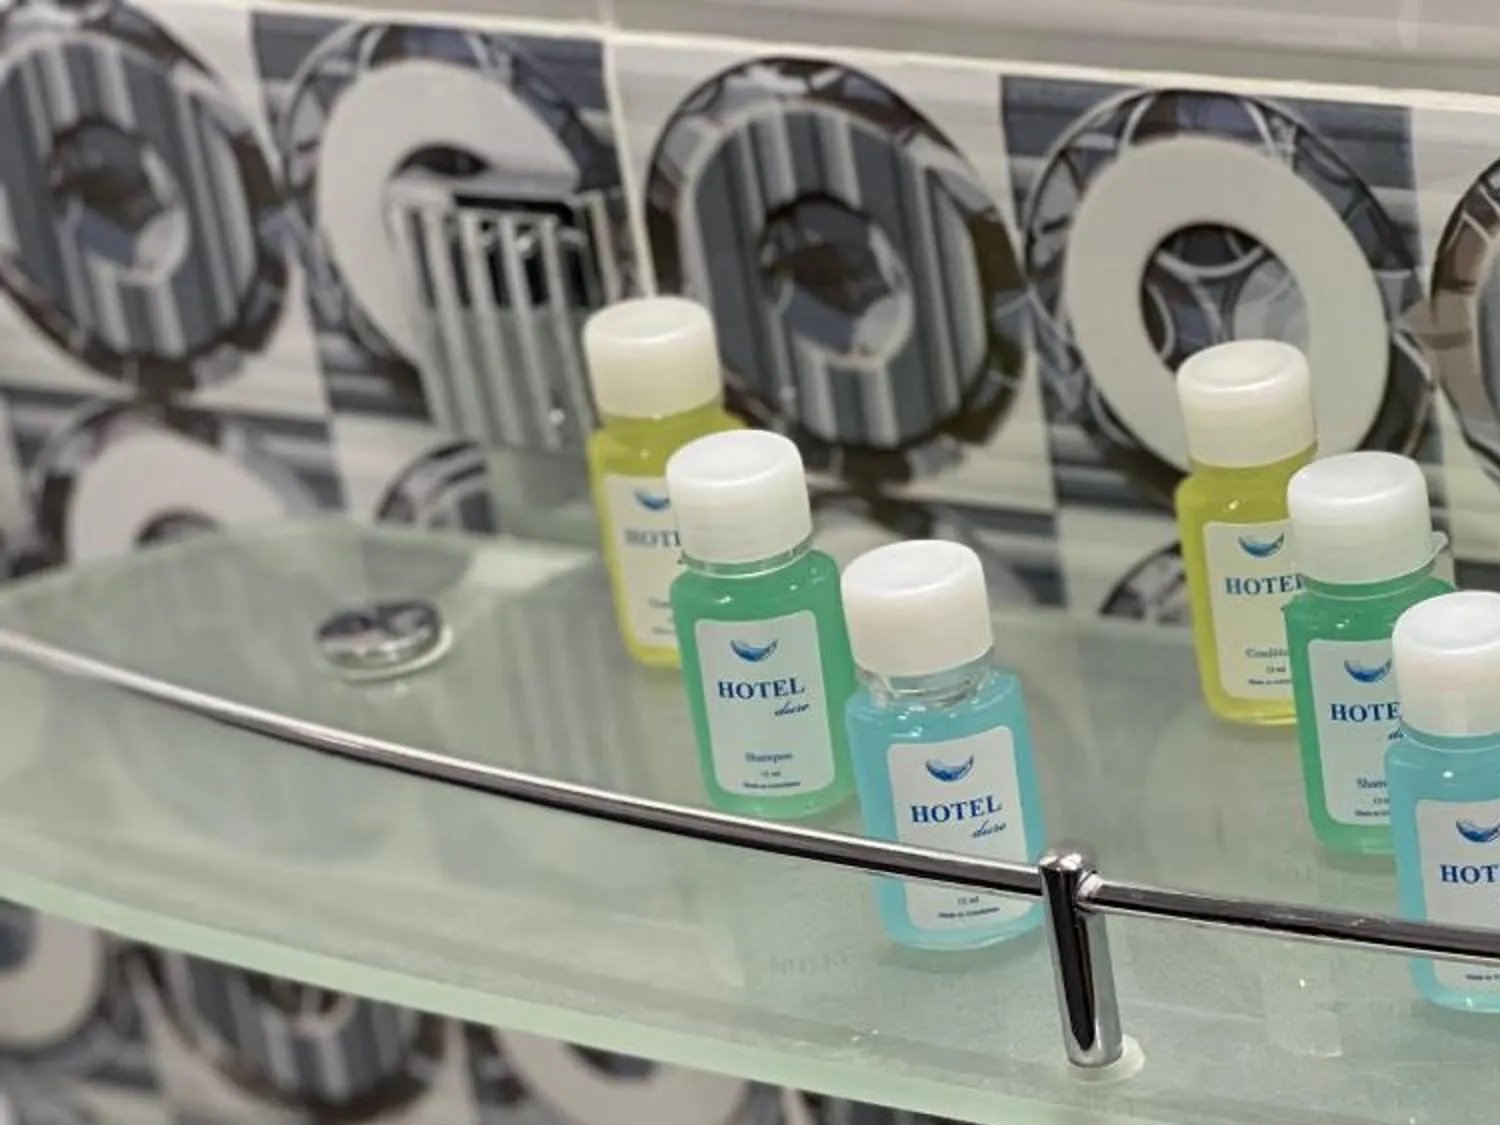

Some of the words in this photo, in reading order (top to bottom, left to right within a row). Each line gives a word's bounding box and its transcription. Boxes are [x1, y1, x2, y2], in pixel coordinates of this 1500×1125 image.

[626, 529, 681, 547] HOT
[718, 677, 805, 700] HOTEL
[1331, 701, 1401, 722] HOTE
[1357, 777, 1387, 789] Sham
[911, 795, 1003, 823] HOTEL
